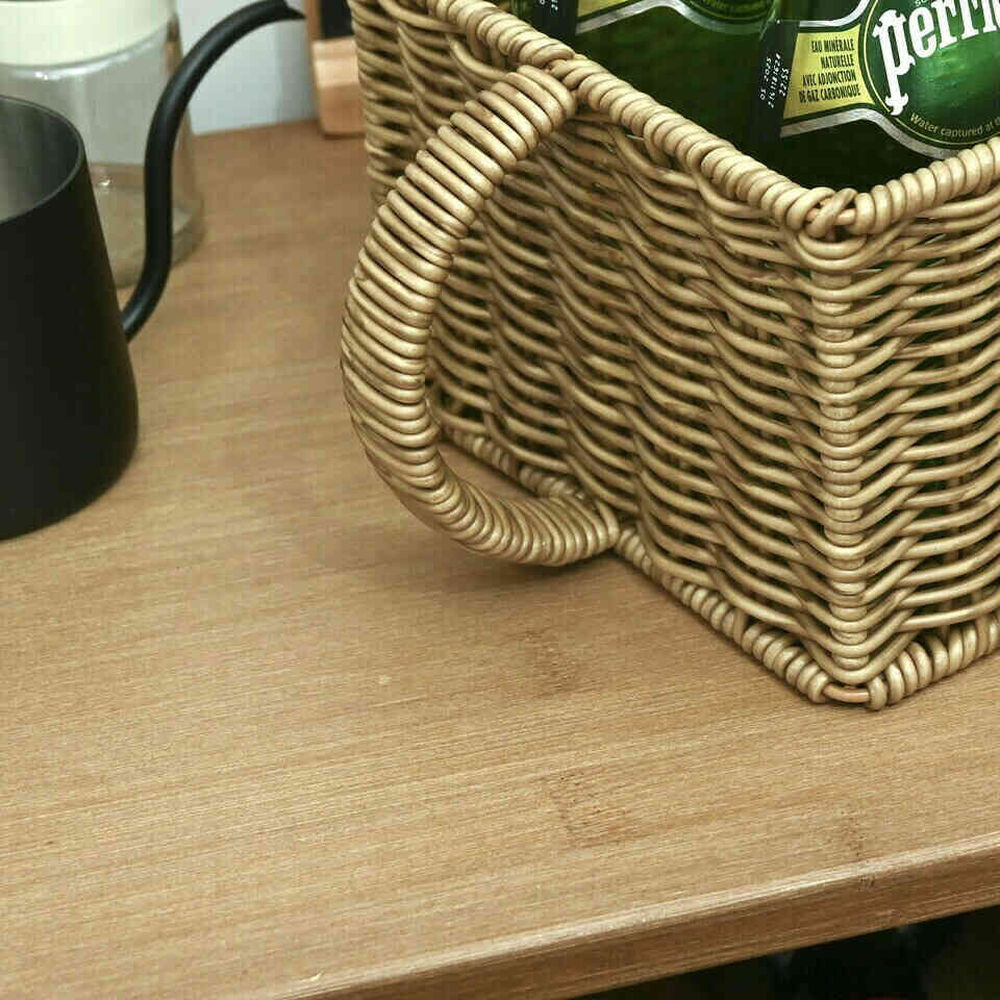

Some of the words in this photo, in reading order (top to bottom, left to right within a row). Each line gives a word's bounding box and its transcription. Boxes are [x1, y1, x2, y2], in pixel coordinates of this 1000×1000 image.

[811, 40, 823, 52] EAU
[820, 54, 854, 69] NATURELLE
[802, 74, 817, 87] AVEC
[818, 69, 857, 86] ADJONCTION
[806, 89, 820, 102] GAZ
[820, 84, 861, 101] CARBONIQUE
[910, 112, 939, 133] Water
[940, 126, 983, 138] captured
